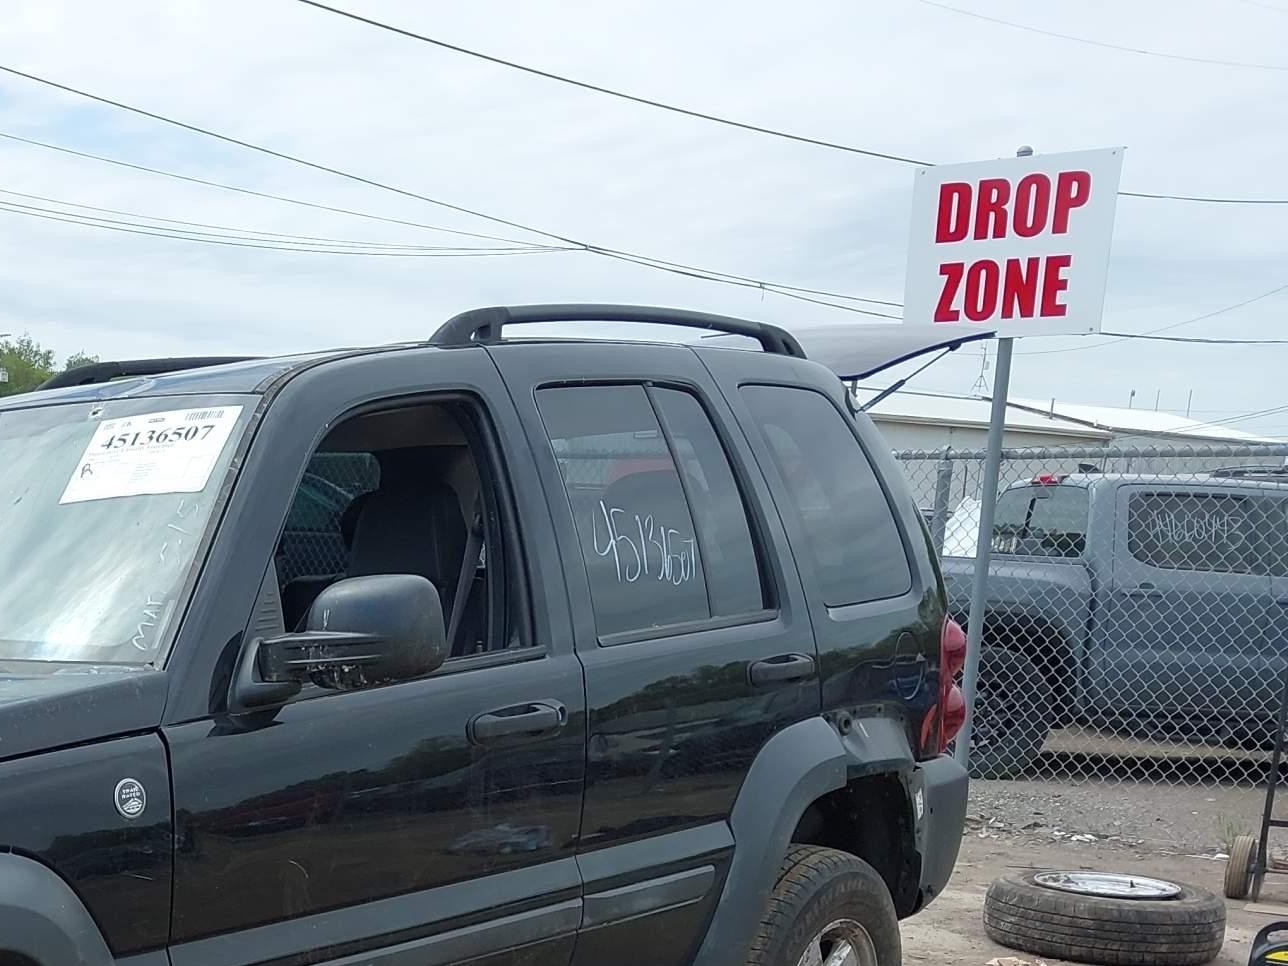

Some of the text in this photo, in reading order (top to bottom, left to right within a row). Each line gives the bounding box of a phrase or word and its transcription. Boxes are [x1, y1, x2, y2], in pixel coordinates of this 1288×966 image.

[934, 170, 1092, 244] DROP
[933, 254, 1073, 323] ZONE
[101, 424, 215, 450] 45136507
[592, 500, 697, 586] 45136507
